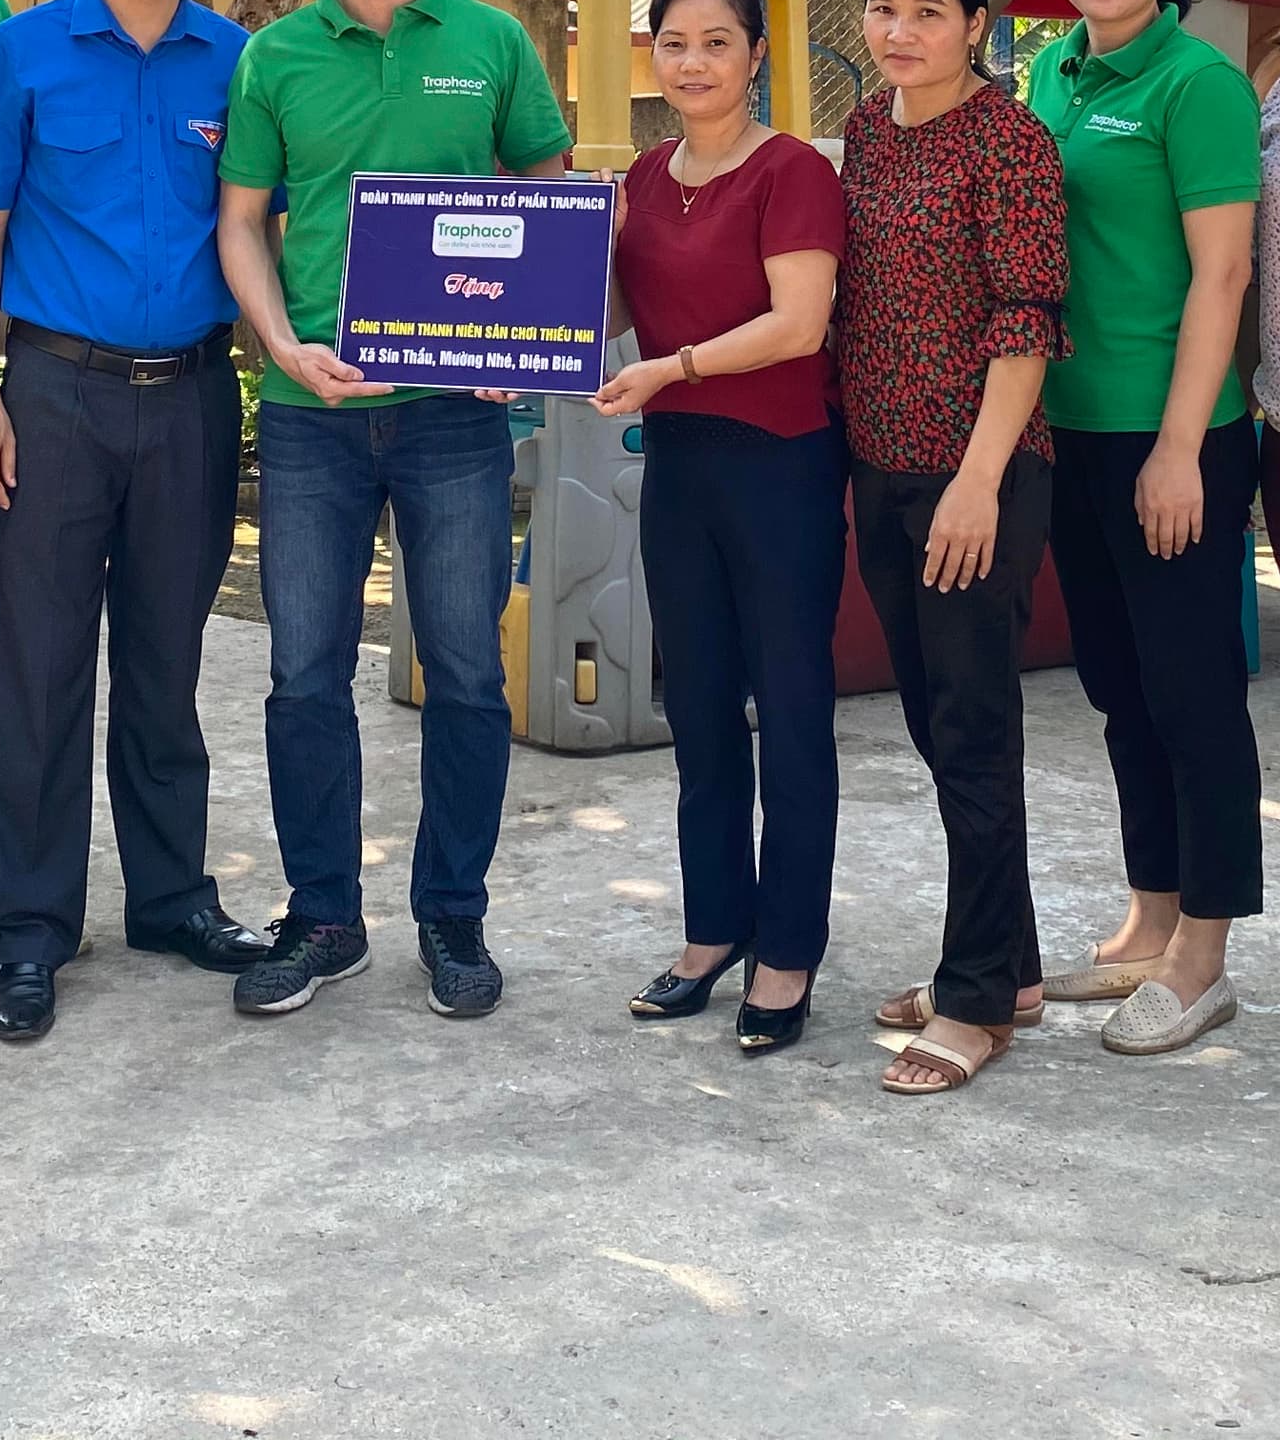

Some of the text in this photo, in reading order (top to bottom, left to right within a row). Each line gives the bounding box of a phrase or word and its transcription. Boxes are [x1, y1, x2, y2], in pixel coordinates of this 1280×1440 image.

[422, 76, 483, 90] Traphaco
[391, 192, 426, 206] THANH
[427, 191, 453, 207] NIÊN
[455, 192, 484, 207] CÔNG
[486, 194, 499, 208] TY
[550, 196, 606, 211] TRAPHACO
[438, 223, 513, 240] Traphaco
[444, 273, 504, 300] Tặng
[350, 319, 381, 334] CÔNG
[382, 320, 416, 336] TRÌNH
[417, 323, 453, 337] THANH
[455, 322, 483, 338] NIÊN
[539, 325, 572, 342] THIẾU
[574, 329, 595, 343] NHI
[358, 347, 376, 363] Xã
[439, 350, 484, 369] Mường
[519, 354, 549, 373] Điện
[552, 355, 583, 372] Biên
